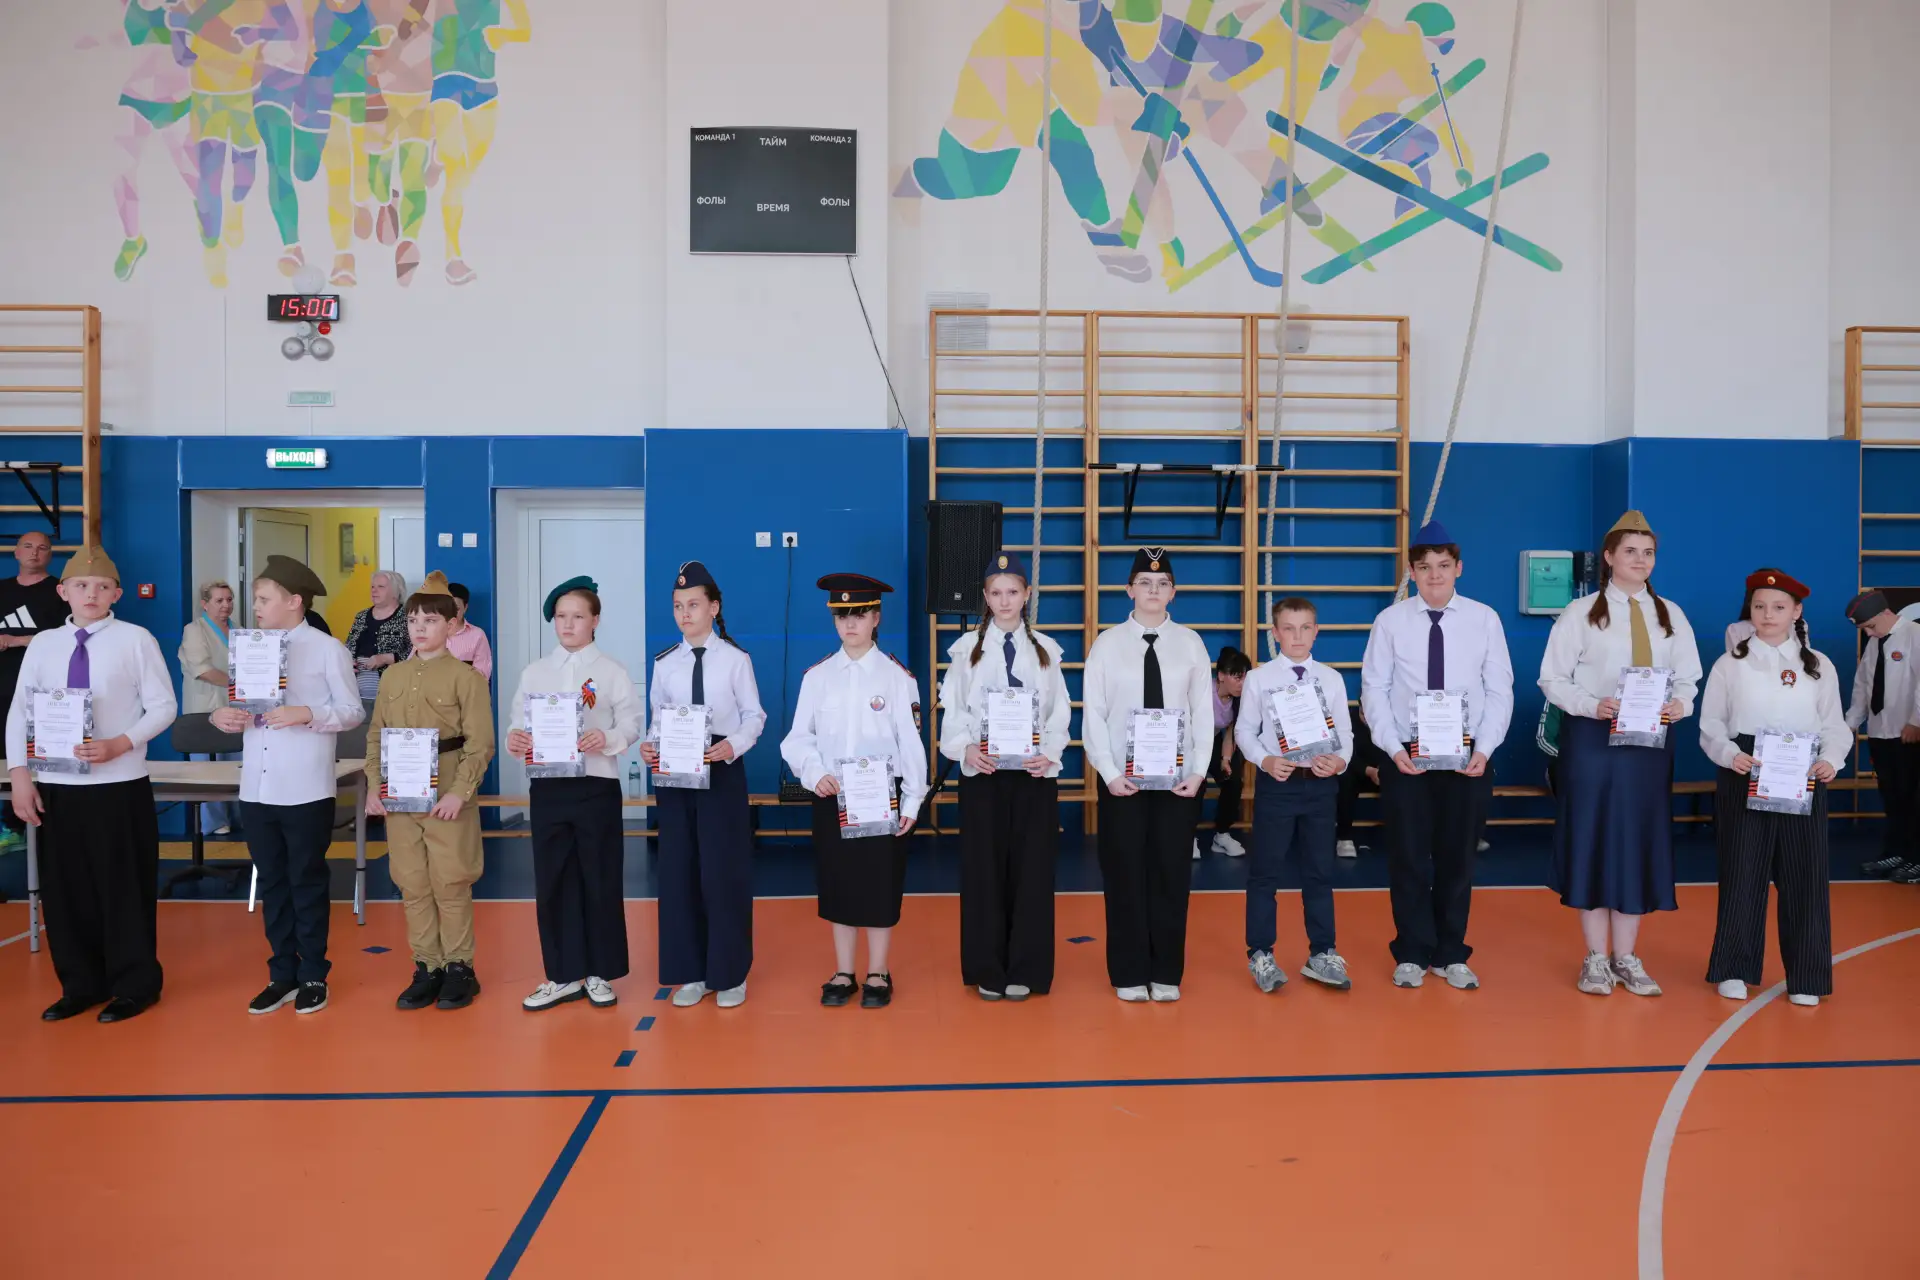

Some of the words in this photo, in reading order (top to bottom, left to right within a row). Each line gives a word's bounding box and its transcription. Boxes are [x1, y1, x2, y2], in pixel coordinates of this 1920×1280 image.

[695, 134, 731, 142] КОМАНДА
[759, 136, 787, 146] ТАЙМ
[810, 135, 846, 144] КОМАНДА
[696, 196, 726, 205] ФОЛЫ
[820, 198, 850, 207] ФОЛЫ
[756, 204, 790, 212] ВРЕМЯ
[280, 298, 335, 316] 15:00
[276, 451, 314, 464] ВЫХОД
